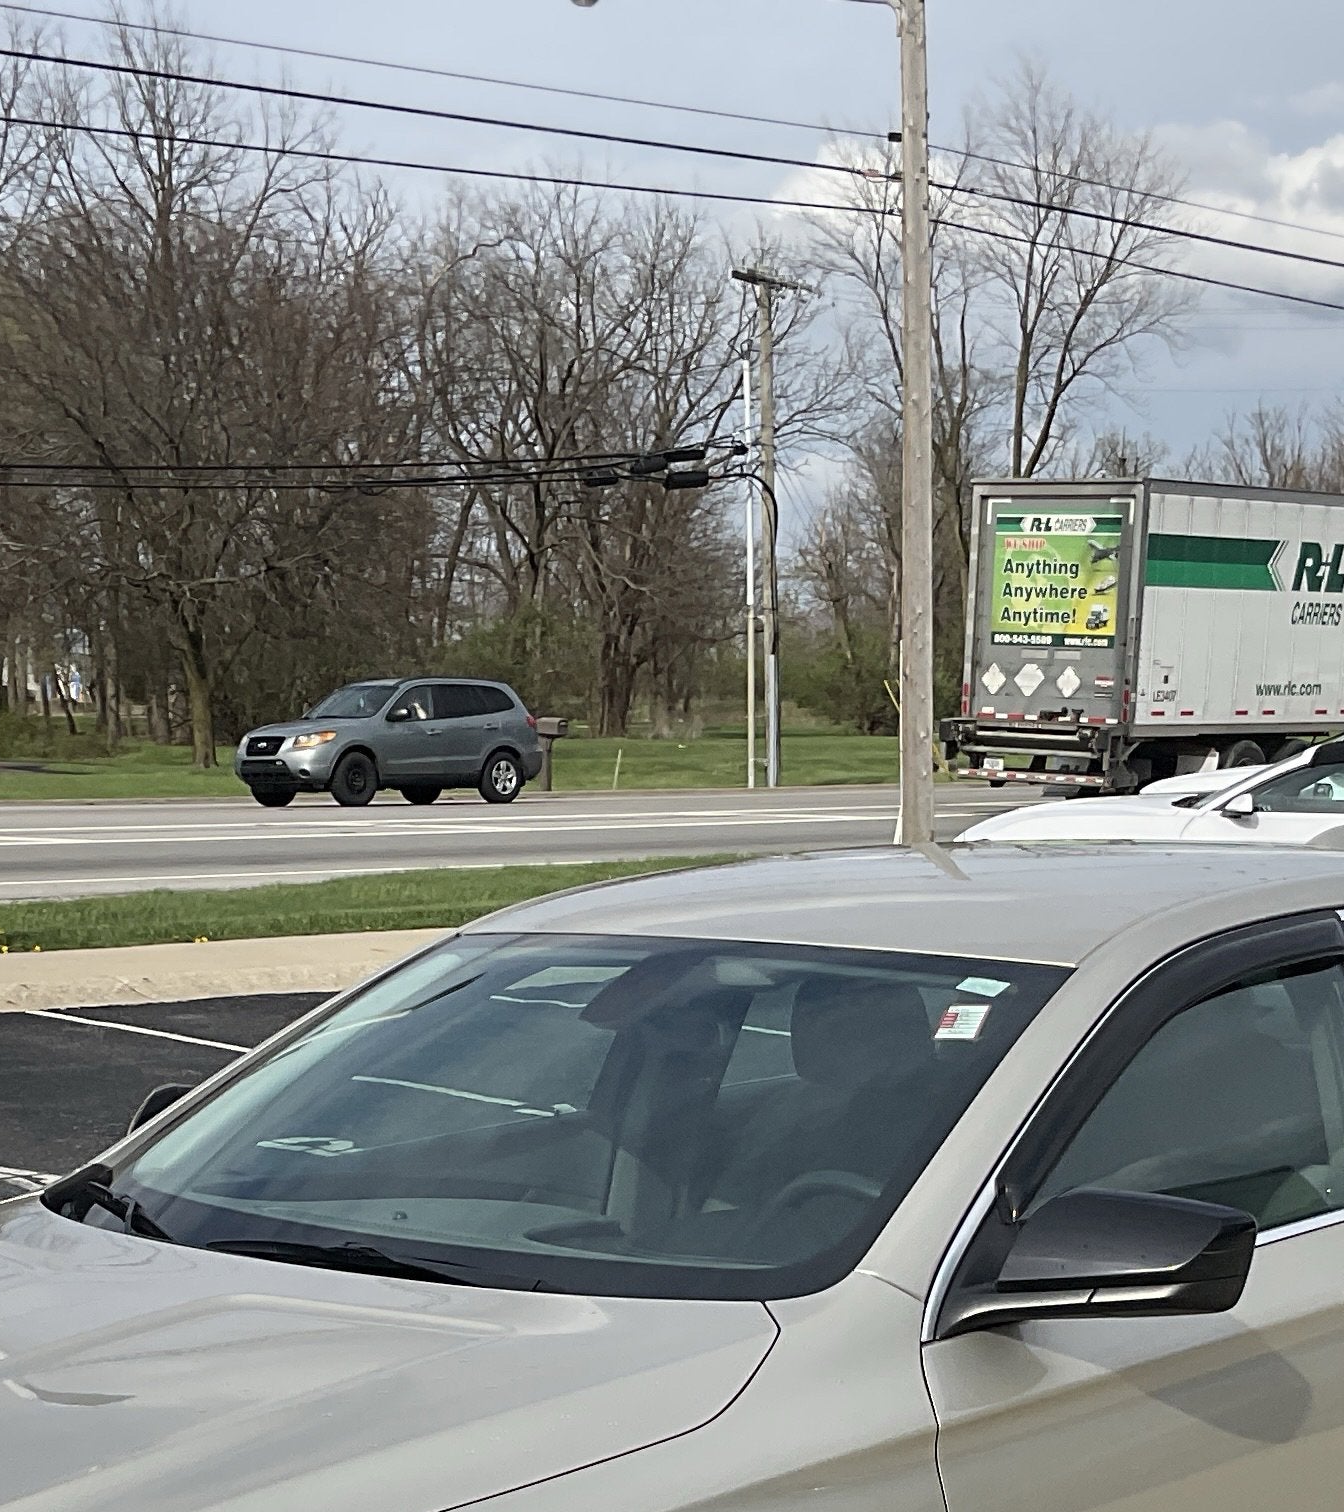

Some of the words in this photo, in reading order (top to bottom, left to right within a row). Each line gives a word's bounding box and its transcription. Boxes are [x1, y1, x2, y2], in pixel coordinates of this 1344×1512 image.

[1003, 558, 1080, 579] Anything
[1002, 582, 1088, 602] Anywhere
[1000, 606, 1077, 627] Anytime!
[1291, 601, 1343, 626] CARRIERS
